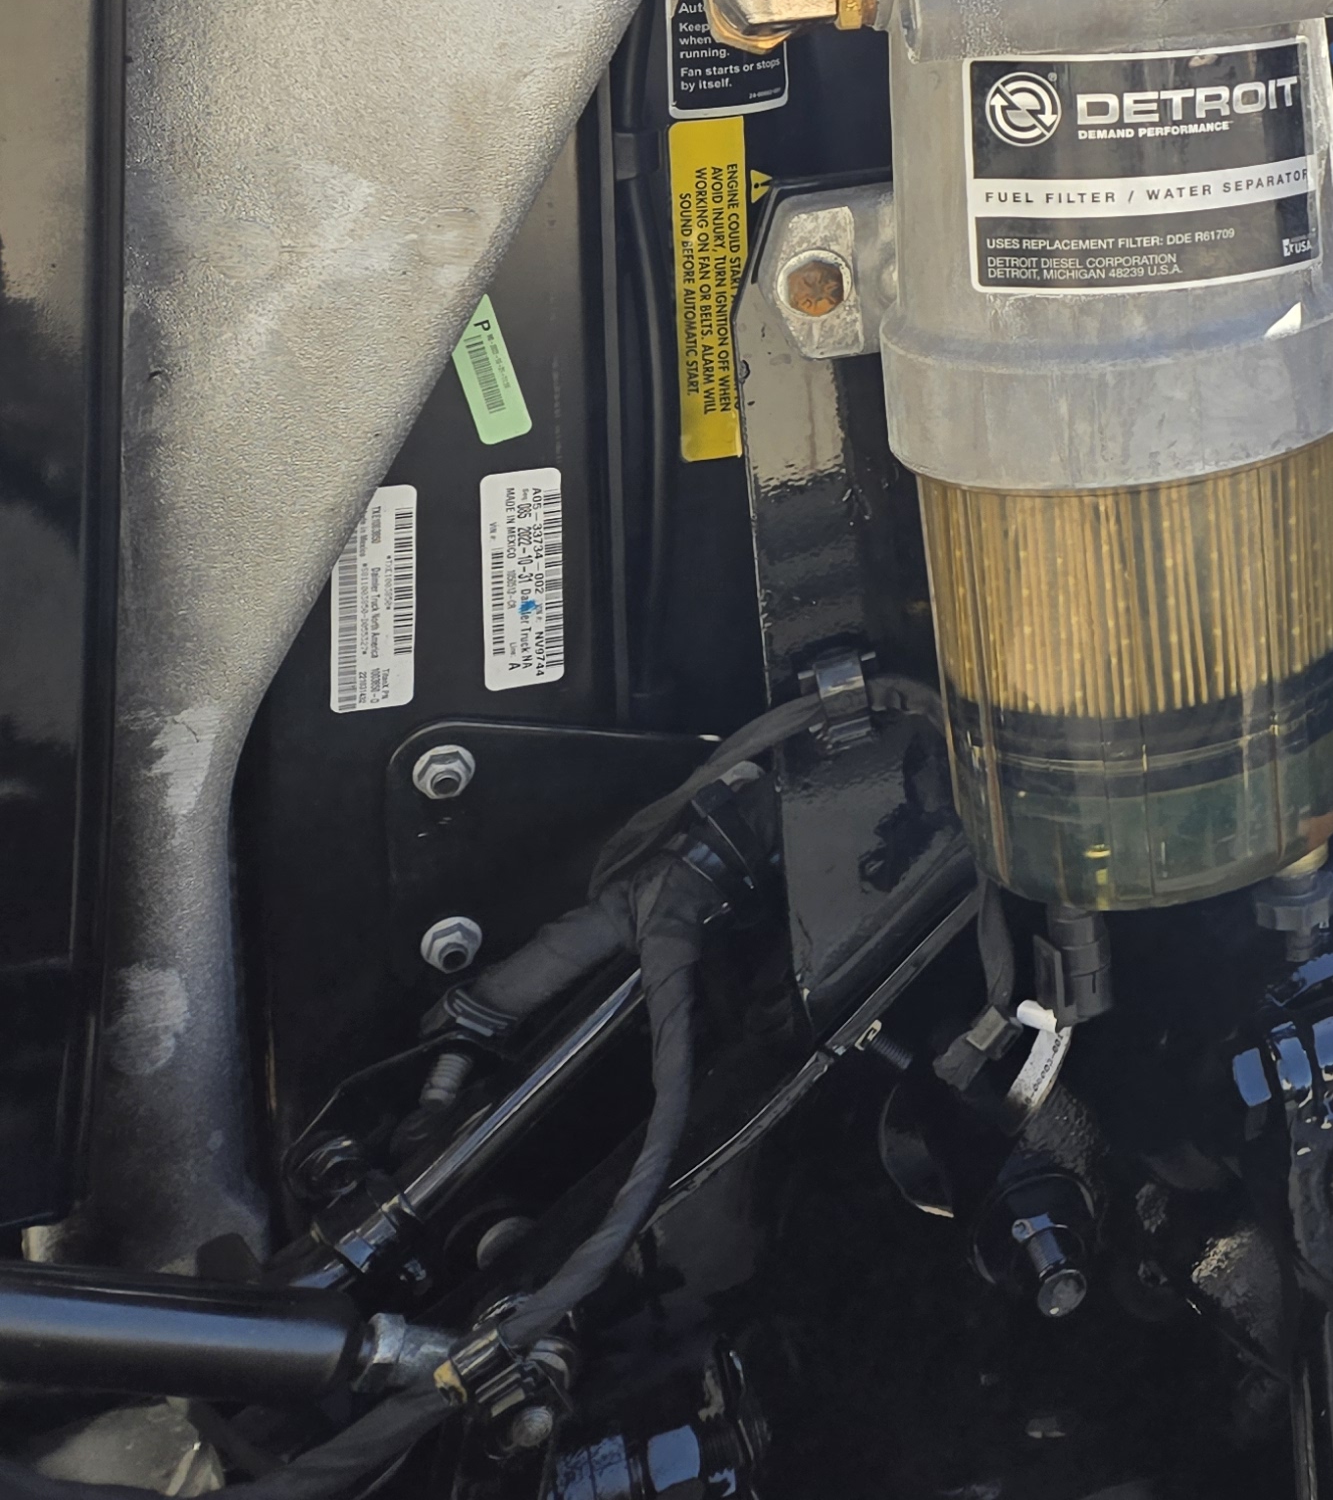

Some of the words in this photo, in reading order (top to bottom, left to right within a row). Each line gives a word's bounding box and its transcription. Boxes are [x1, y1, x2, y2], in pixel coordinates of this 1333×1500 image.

[679, 35, 712, 46] when
[680, 47, 730, 60] running.
[680, 66, 702, 77] Fan
[705, 64, 741, 75] starts
[743, 62, 755, 72] or
[756, 57, 781, 72] stops
[680, 80, 696, 93] by
[699, 77, 733, 90] itself.
[1075, 75, 1298, 126] DETROIT
[1077, 128, 1135, 140] DEMAND
[1137, 121, 1231, 138] PERFORMANCE
[711, 165, 723, 203] AVOID
[727, 162, 740, 210] ENGINE
[984, 191, 1034, 204] FUEL
[1044, 191, 1116, 204] FILTER
[1127, 190, 1135, 203] /
[1146, 184, 1213, 200] WATER
[694, 167, 710, 228] WORKING
[679, 192, 692, 238] SOUND
[712, 204, 727, 252] INJURY,
[697, 230, 710, 247] ON
[729, 211, 741, 254] COULD
[986, 238, 1020, 250] USES
[1022, 236, 1115, 251] REPLACEMENT
[1117, 234, 1164, 249] FILTER:
[1166, 232, 1192, 247] DDE
[1194, 227, 1236, 243] R61709
[681, 241, 694, 288] BEFORE
[698, 247, 711, 280] FAN
[714, 254, 727, 287] TURN
[986, 256, 1039, 269] DETROIT
[1040, 255, 1084, 268] DIESEL
[1085, 252, 1177, 267] CORPORATION
[986, 267, 1041, 281] DETROIT,
[1043, 266, 1106, 281] MICHIGAN
[1108, 266, 1145, 279] 48239
[1147, 264, 1183, 277] U.S.A.
[700, 282, 712, 304] OR
[473, 318, 493, 335] P
[683, 288, 698, 359] AUTOMATIC
[700, 304, 713, 340] BELTS.
[716, 290, 729, 340] IGNITION
[702, 345, 715, 388] ALARM
[718, 342, 730, 370] OFF
[686, 360, 700, 396] START.
[704, 390, 717, 415] WILL
[719, 372, 732, 413] WHEN
[505, 487, 515, 513] MADE
[516, 502, 531, 520] 085
[506, 515, 516, 526] IN
[506, 526, 516, 560] MEXICO
[371, 567, 381, 593] Daimler
[371, 594, 380, 612] Truck
[371, 613, 380, 631] North
[370, 632, 379, 659] America
[520, 627, 532, 653] Truck
[508, 661, 521, 671] A
[522, 654, 532, 670] NA
[535, 631, 545, 677] NV9744
